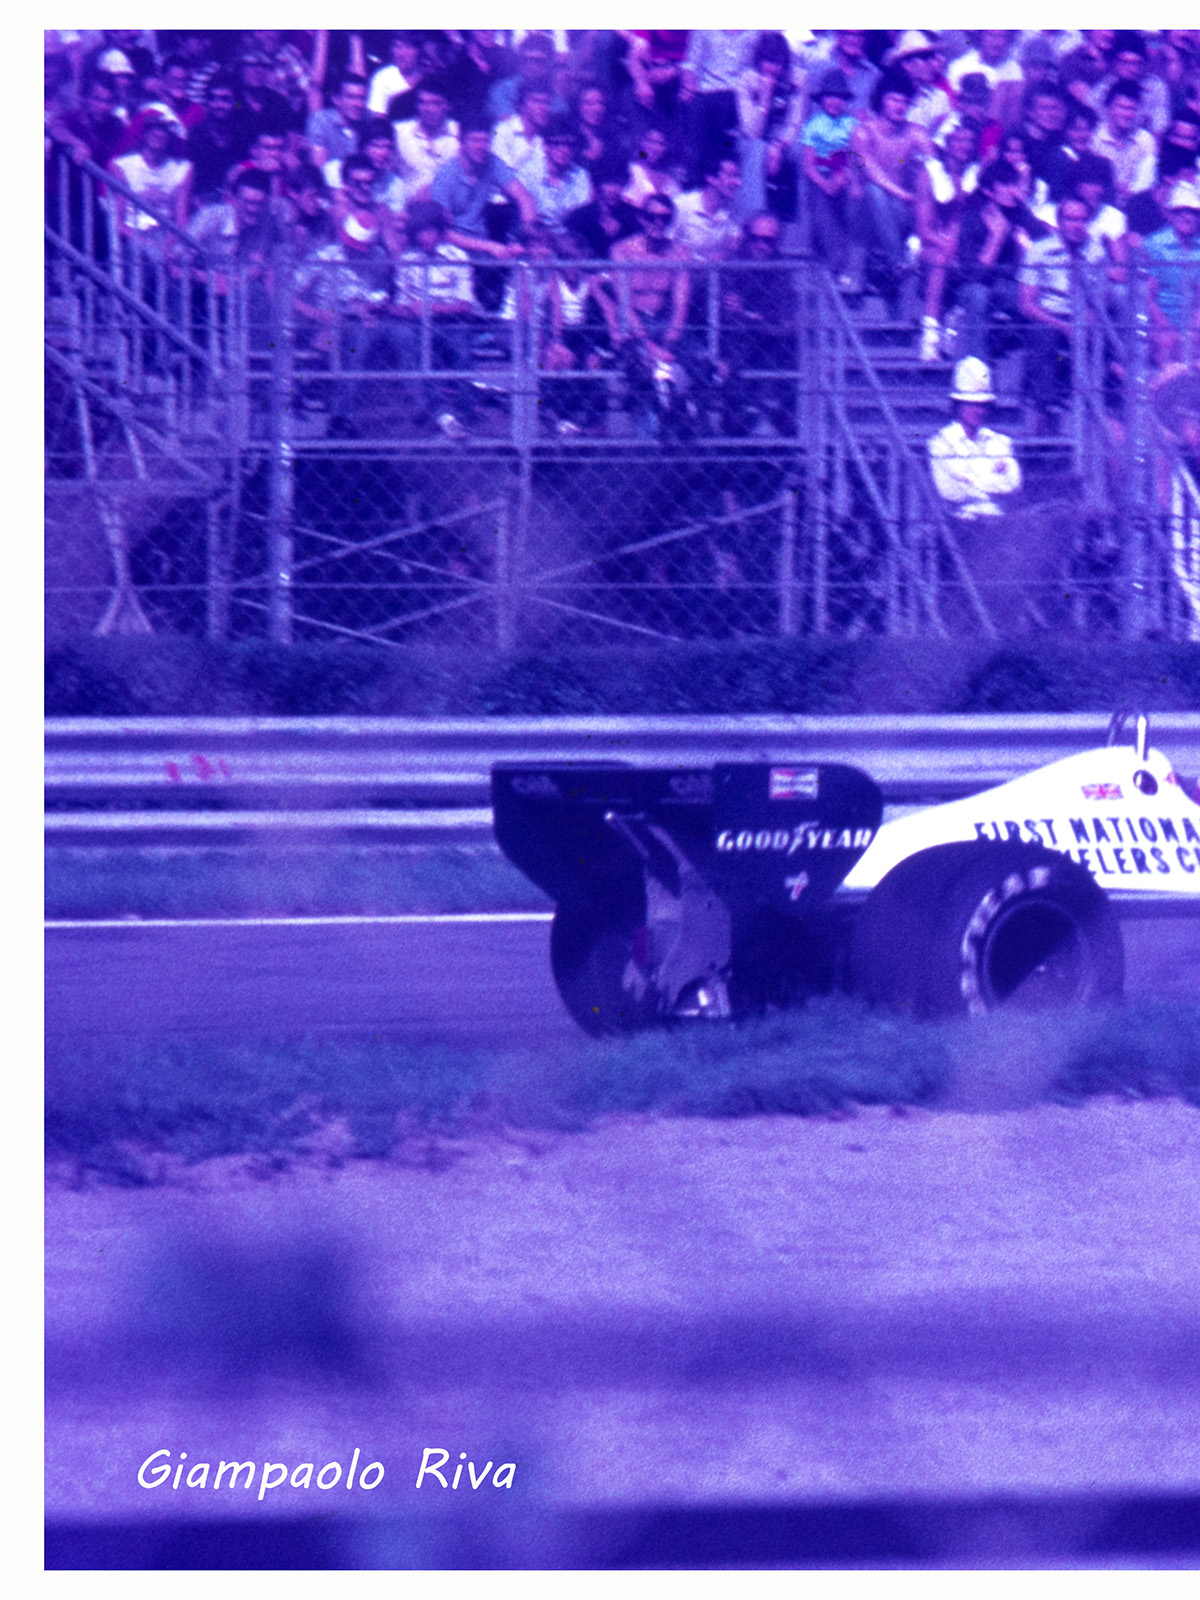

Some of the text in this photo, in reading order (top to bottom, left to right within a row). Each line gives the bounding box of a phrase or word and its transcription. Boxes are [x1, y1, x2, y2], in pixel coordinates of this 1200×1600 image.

[716, 825, 873, 853] GOODYEAR
[974, 818, 1057, 846] FIRST
[1064, 847, 1171, 876] ELERS
